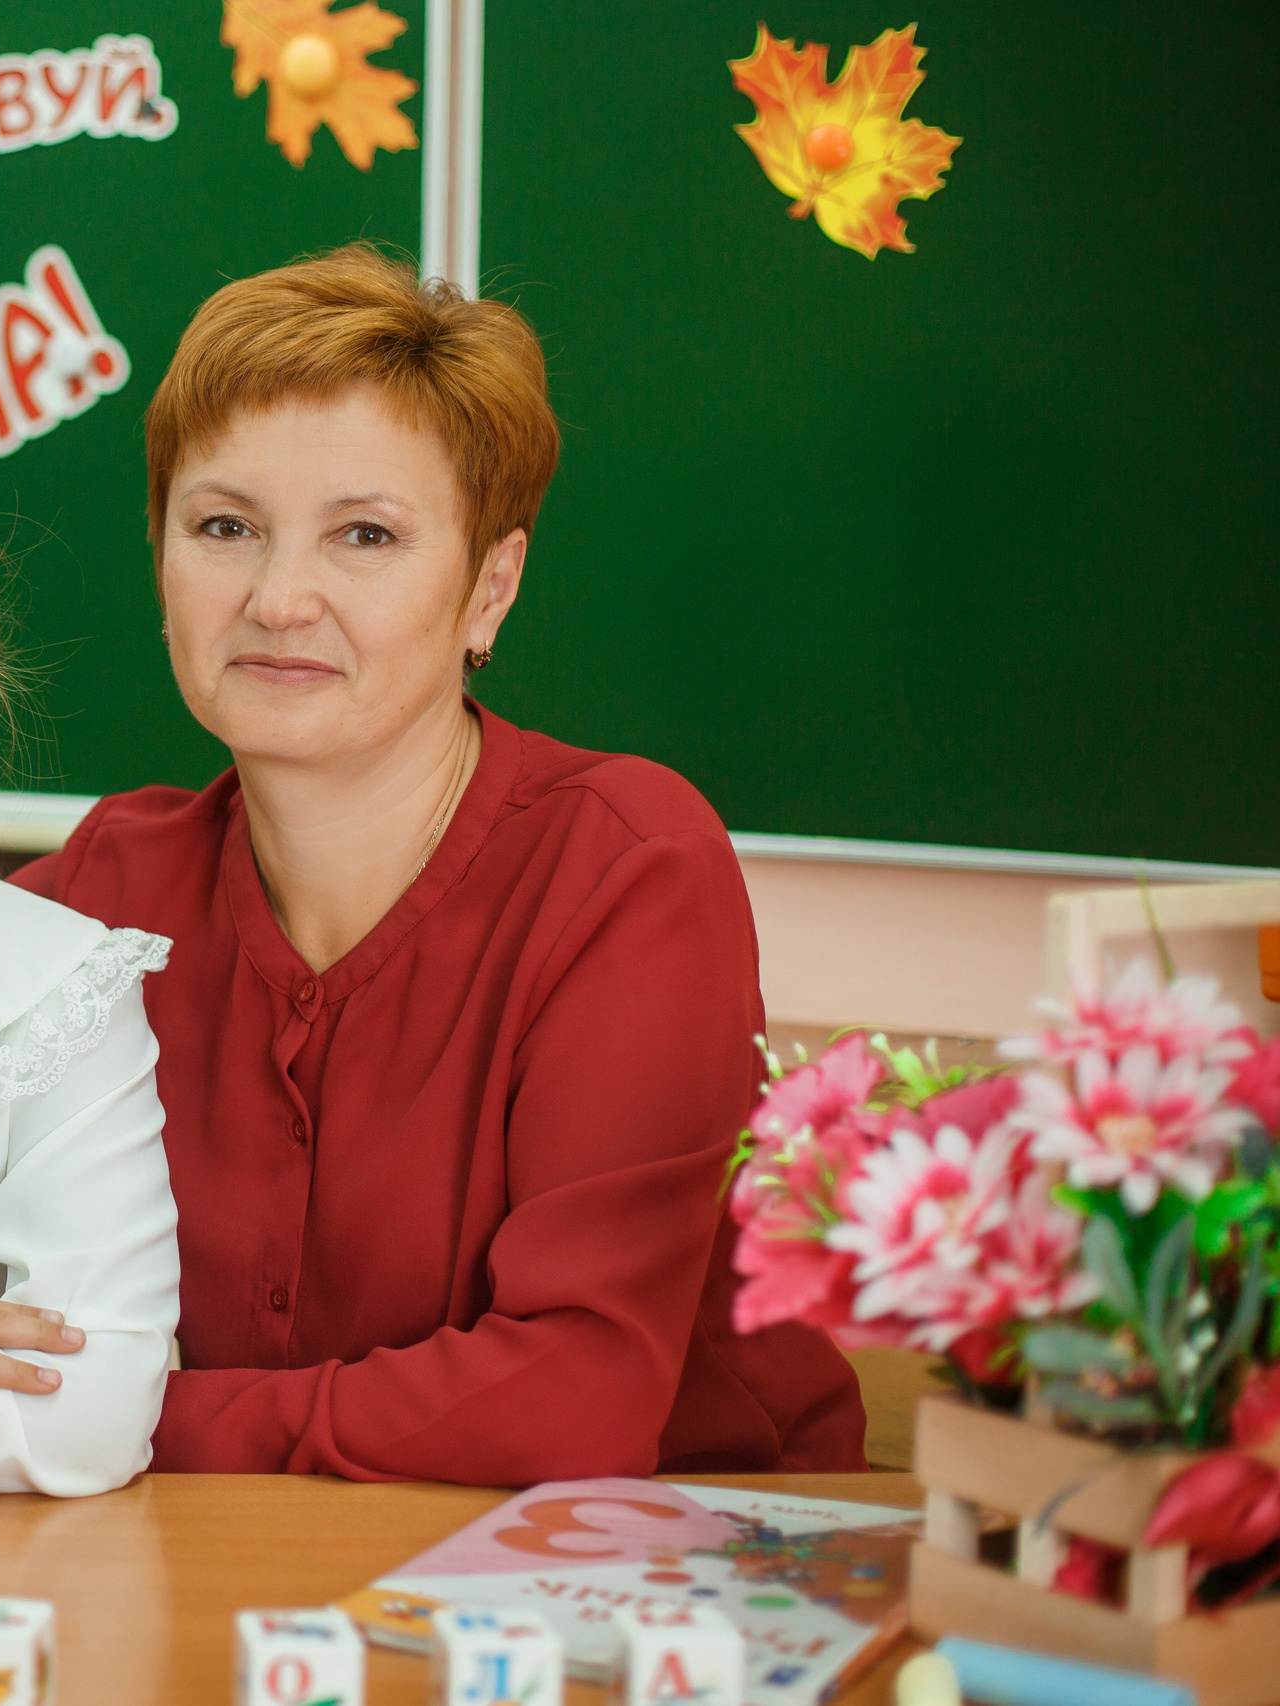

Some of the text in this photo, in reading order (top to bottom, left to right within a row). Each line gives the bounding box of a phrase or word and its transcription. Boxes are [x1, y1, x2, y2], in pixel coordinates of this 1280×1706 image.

[493, 1496, 687, 1560] 3
[466, 1655, 508, 1698] Л
[645, 1650, 696, 1699] А
